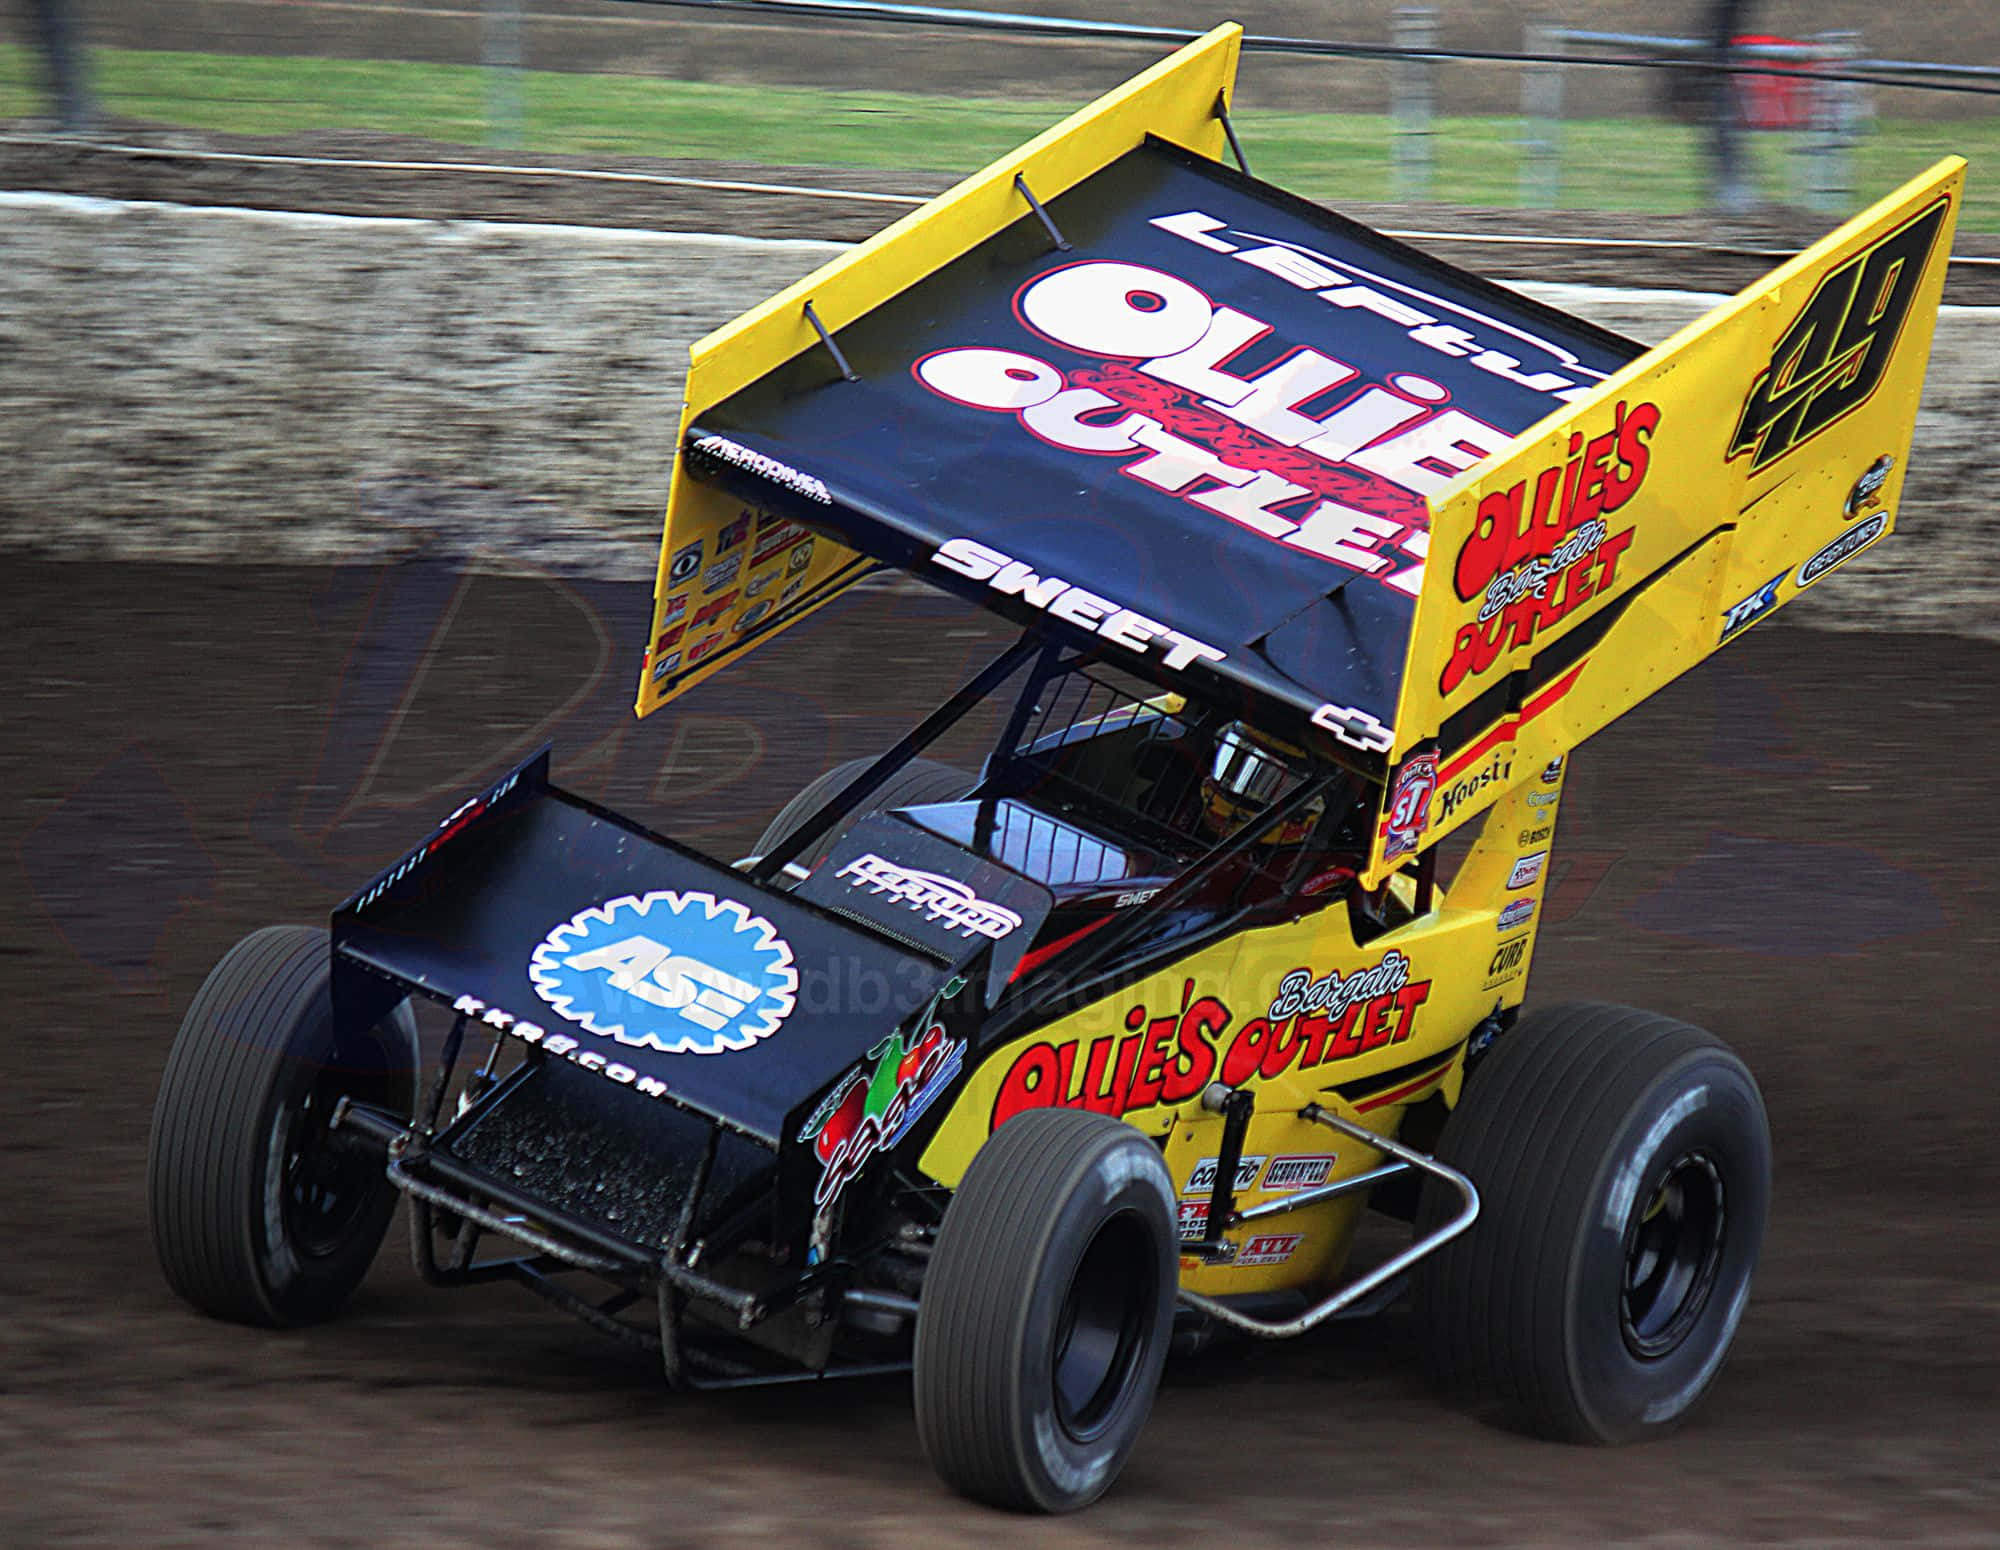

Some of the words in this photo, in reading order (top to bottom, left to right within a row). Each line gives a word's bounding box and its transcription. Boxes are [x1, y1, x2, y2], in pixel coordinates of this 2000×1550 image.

[1725, 192, 1952, 478] 49
[1453, 401, 1661, 603] OLLIE'S
[931, 537, 1227, 671] SWEET
[1438, 526, 1635, 697] OUTLET
[562, 935, 763, 1032] ASE
[1268, 950, 1410, 1023] Bargain
[1488, 938, 1528, 977] CURB
[990, 978, 1232, 1134] OLLIE'S
[1220, 979, 1433, 1087] OUTLET
